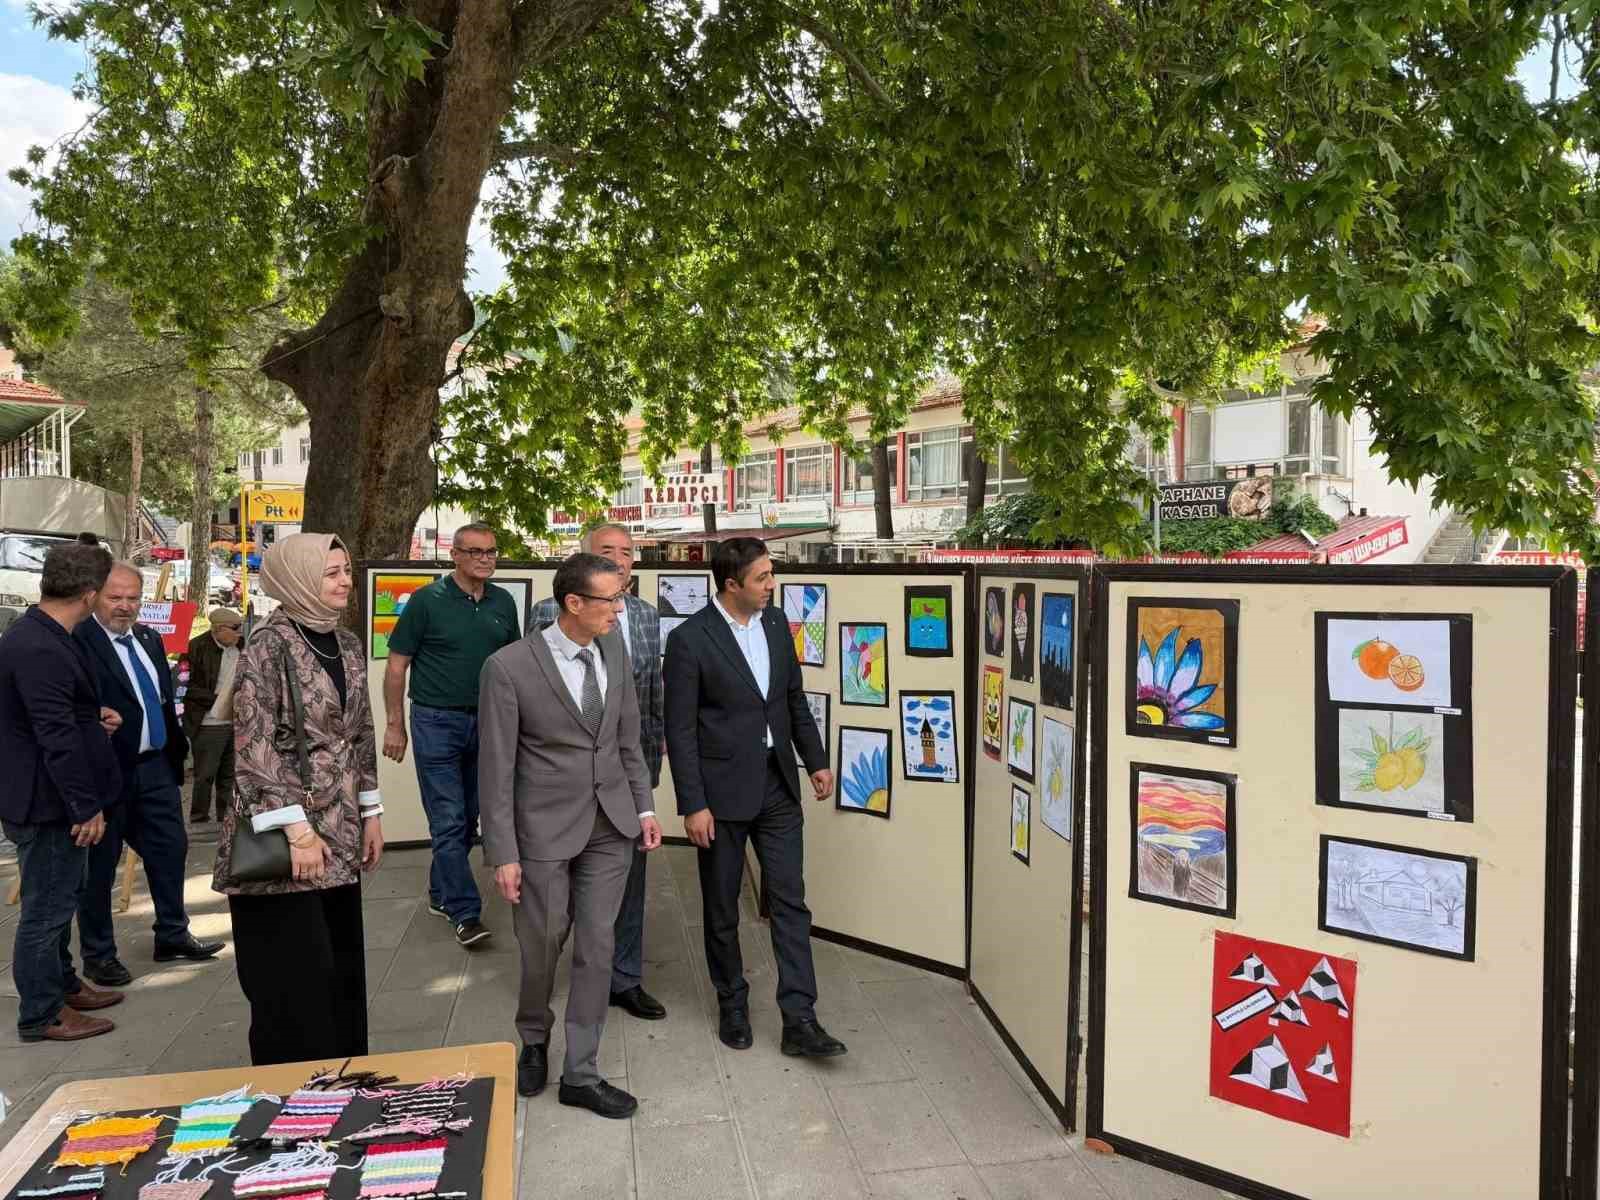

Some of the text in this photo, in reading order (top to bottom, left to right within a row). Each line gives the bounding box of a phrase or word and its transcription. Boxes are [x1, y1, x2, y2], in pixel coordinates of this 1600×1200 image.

[644, 485, 719, 503] KEBAPÇI
[265, 505, 284, 518] Ptt
[1161, 504, 1217, 519] KASABI
